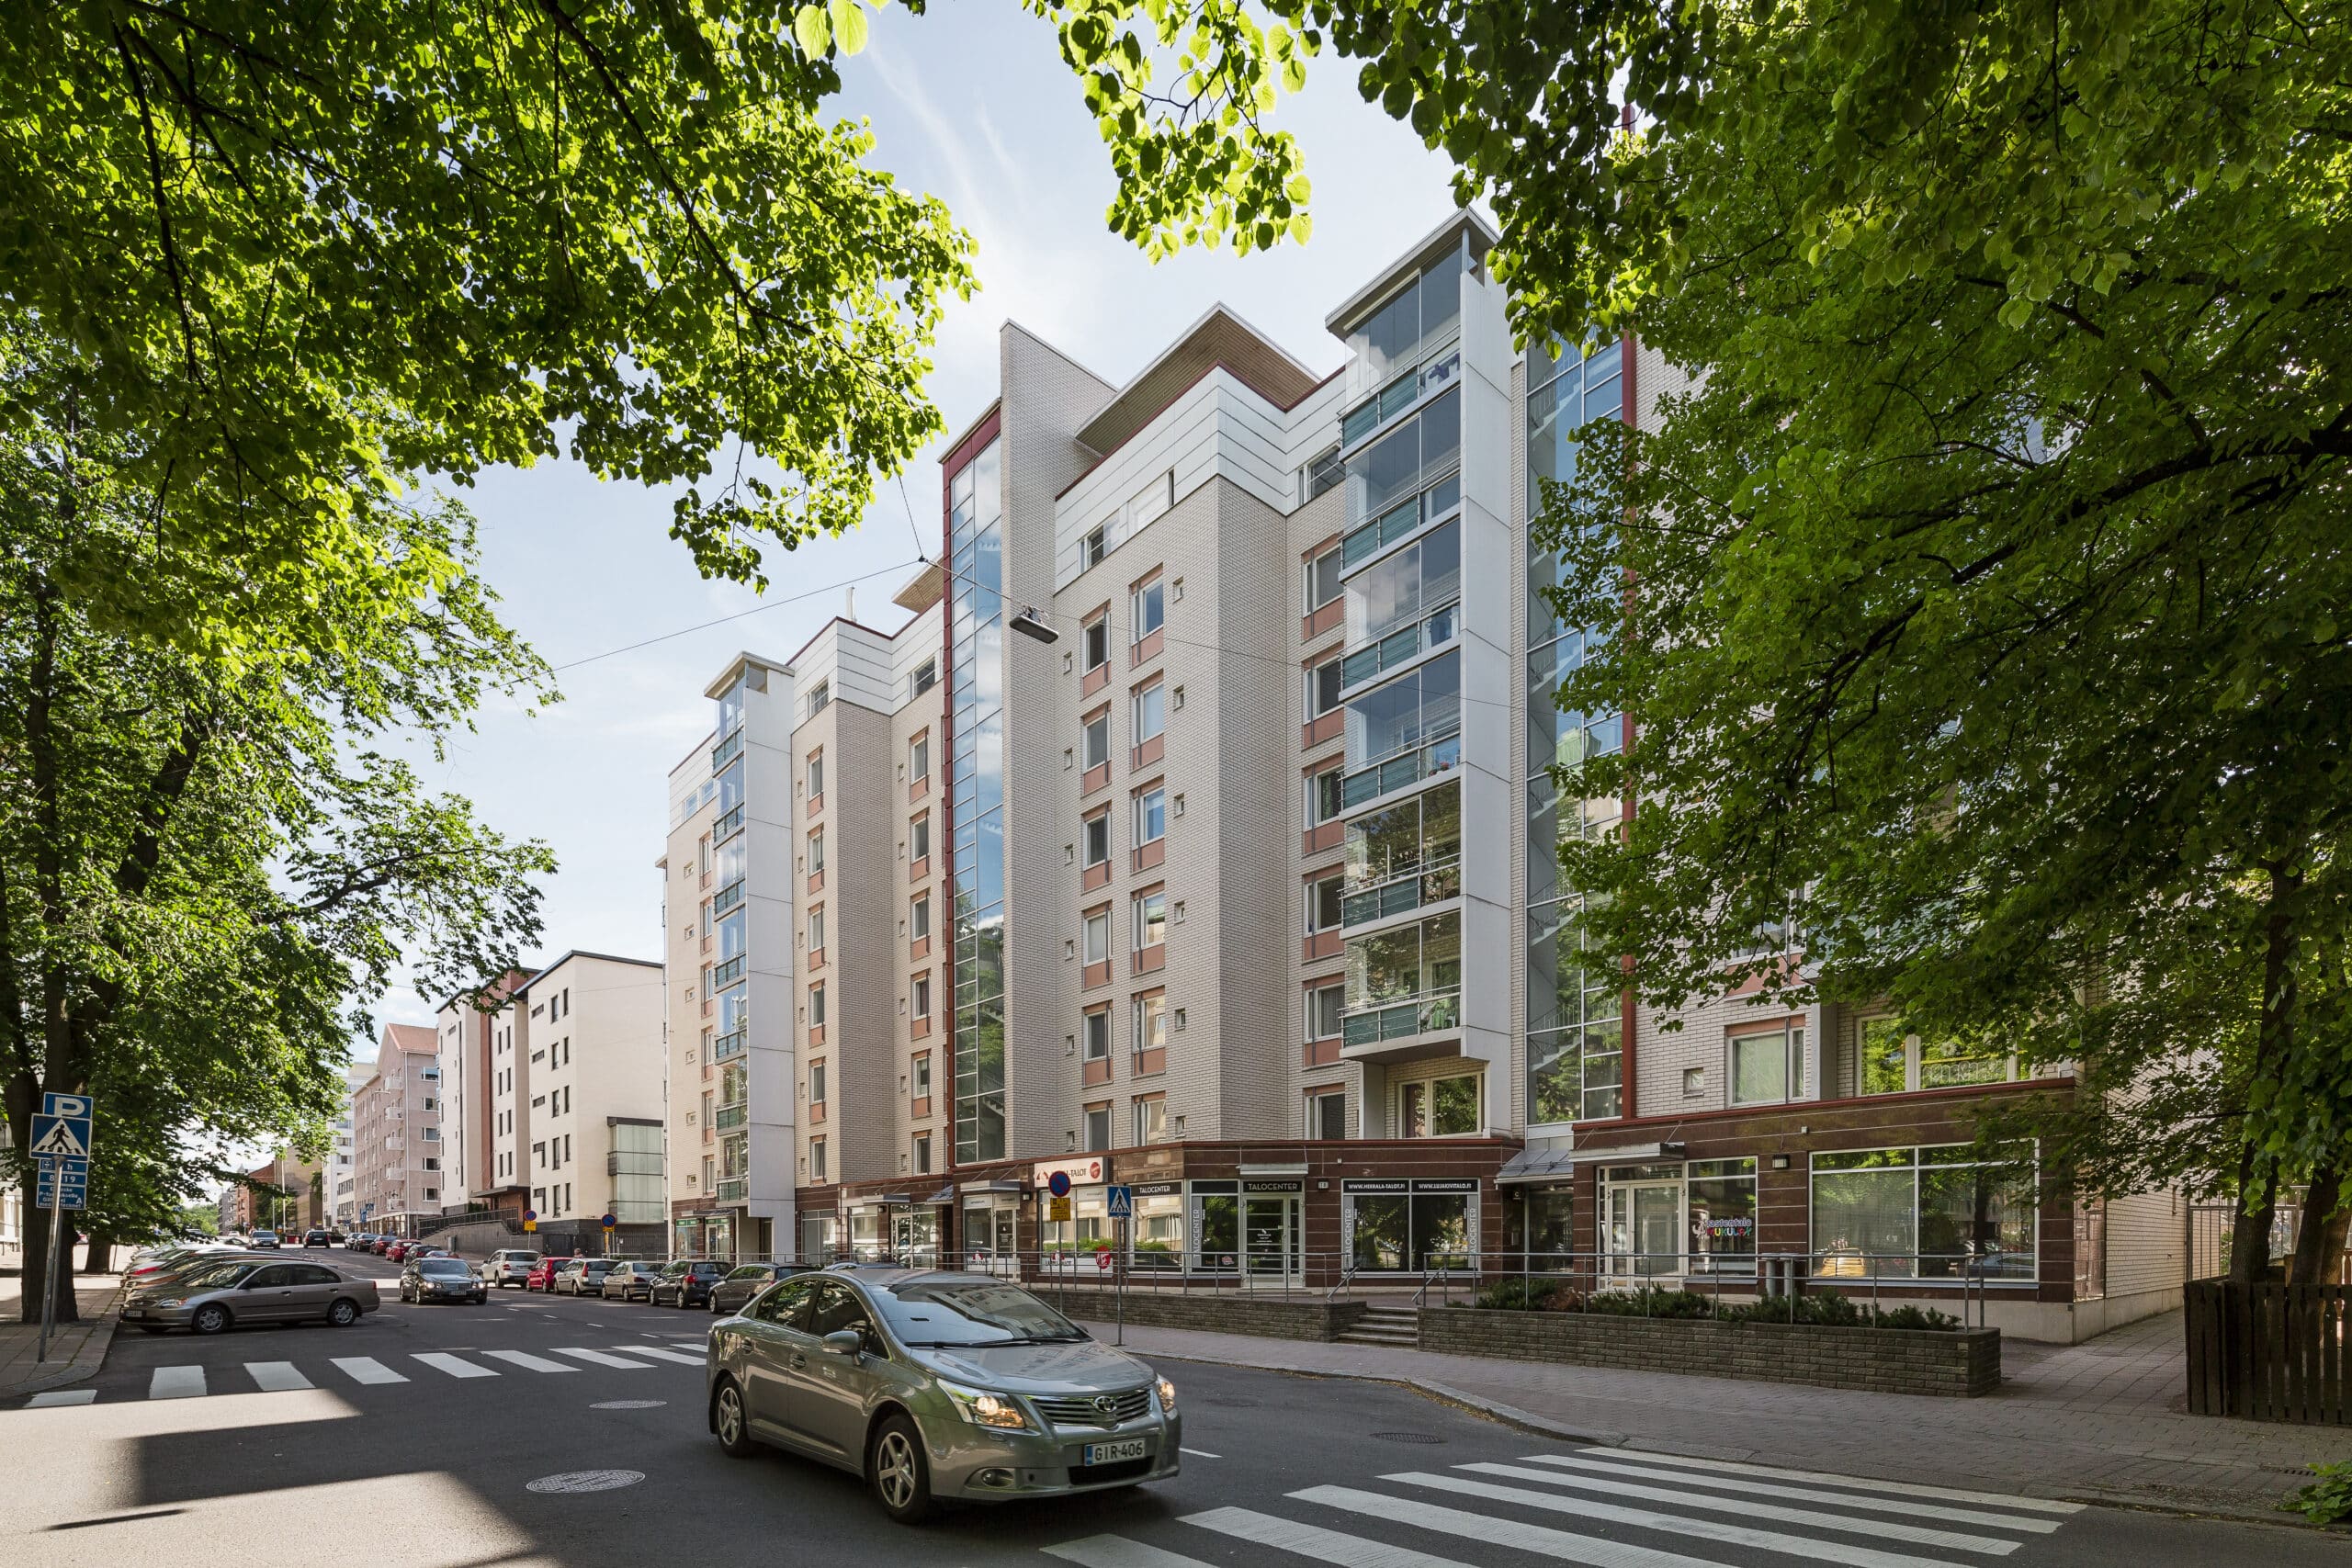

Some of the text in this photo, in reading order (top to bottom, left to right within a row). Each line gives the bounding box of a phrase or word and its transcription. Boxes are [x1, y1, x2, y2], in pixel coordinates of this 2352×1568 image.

[54, 1097, 85, 1117] P
[1139, 1185, 1170, 1193] TALOCENTER
[1248, 1182, 1298, 1190] TALOCENTER
[1344, 1208, 1352, 1255] ALOCENTER
[1469, 1207, 1477, 1254] ALOCENTER
[1094, 1441, 1143, 1461] GIR-406
